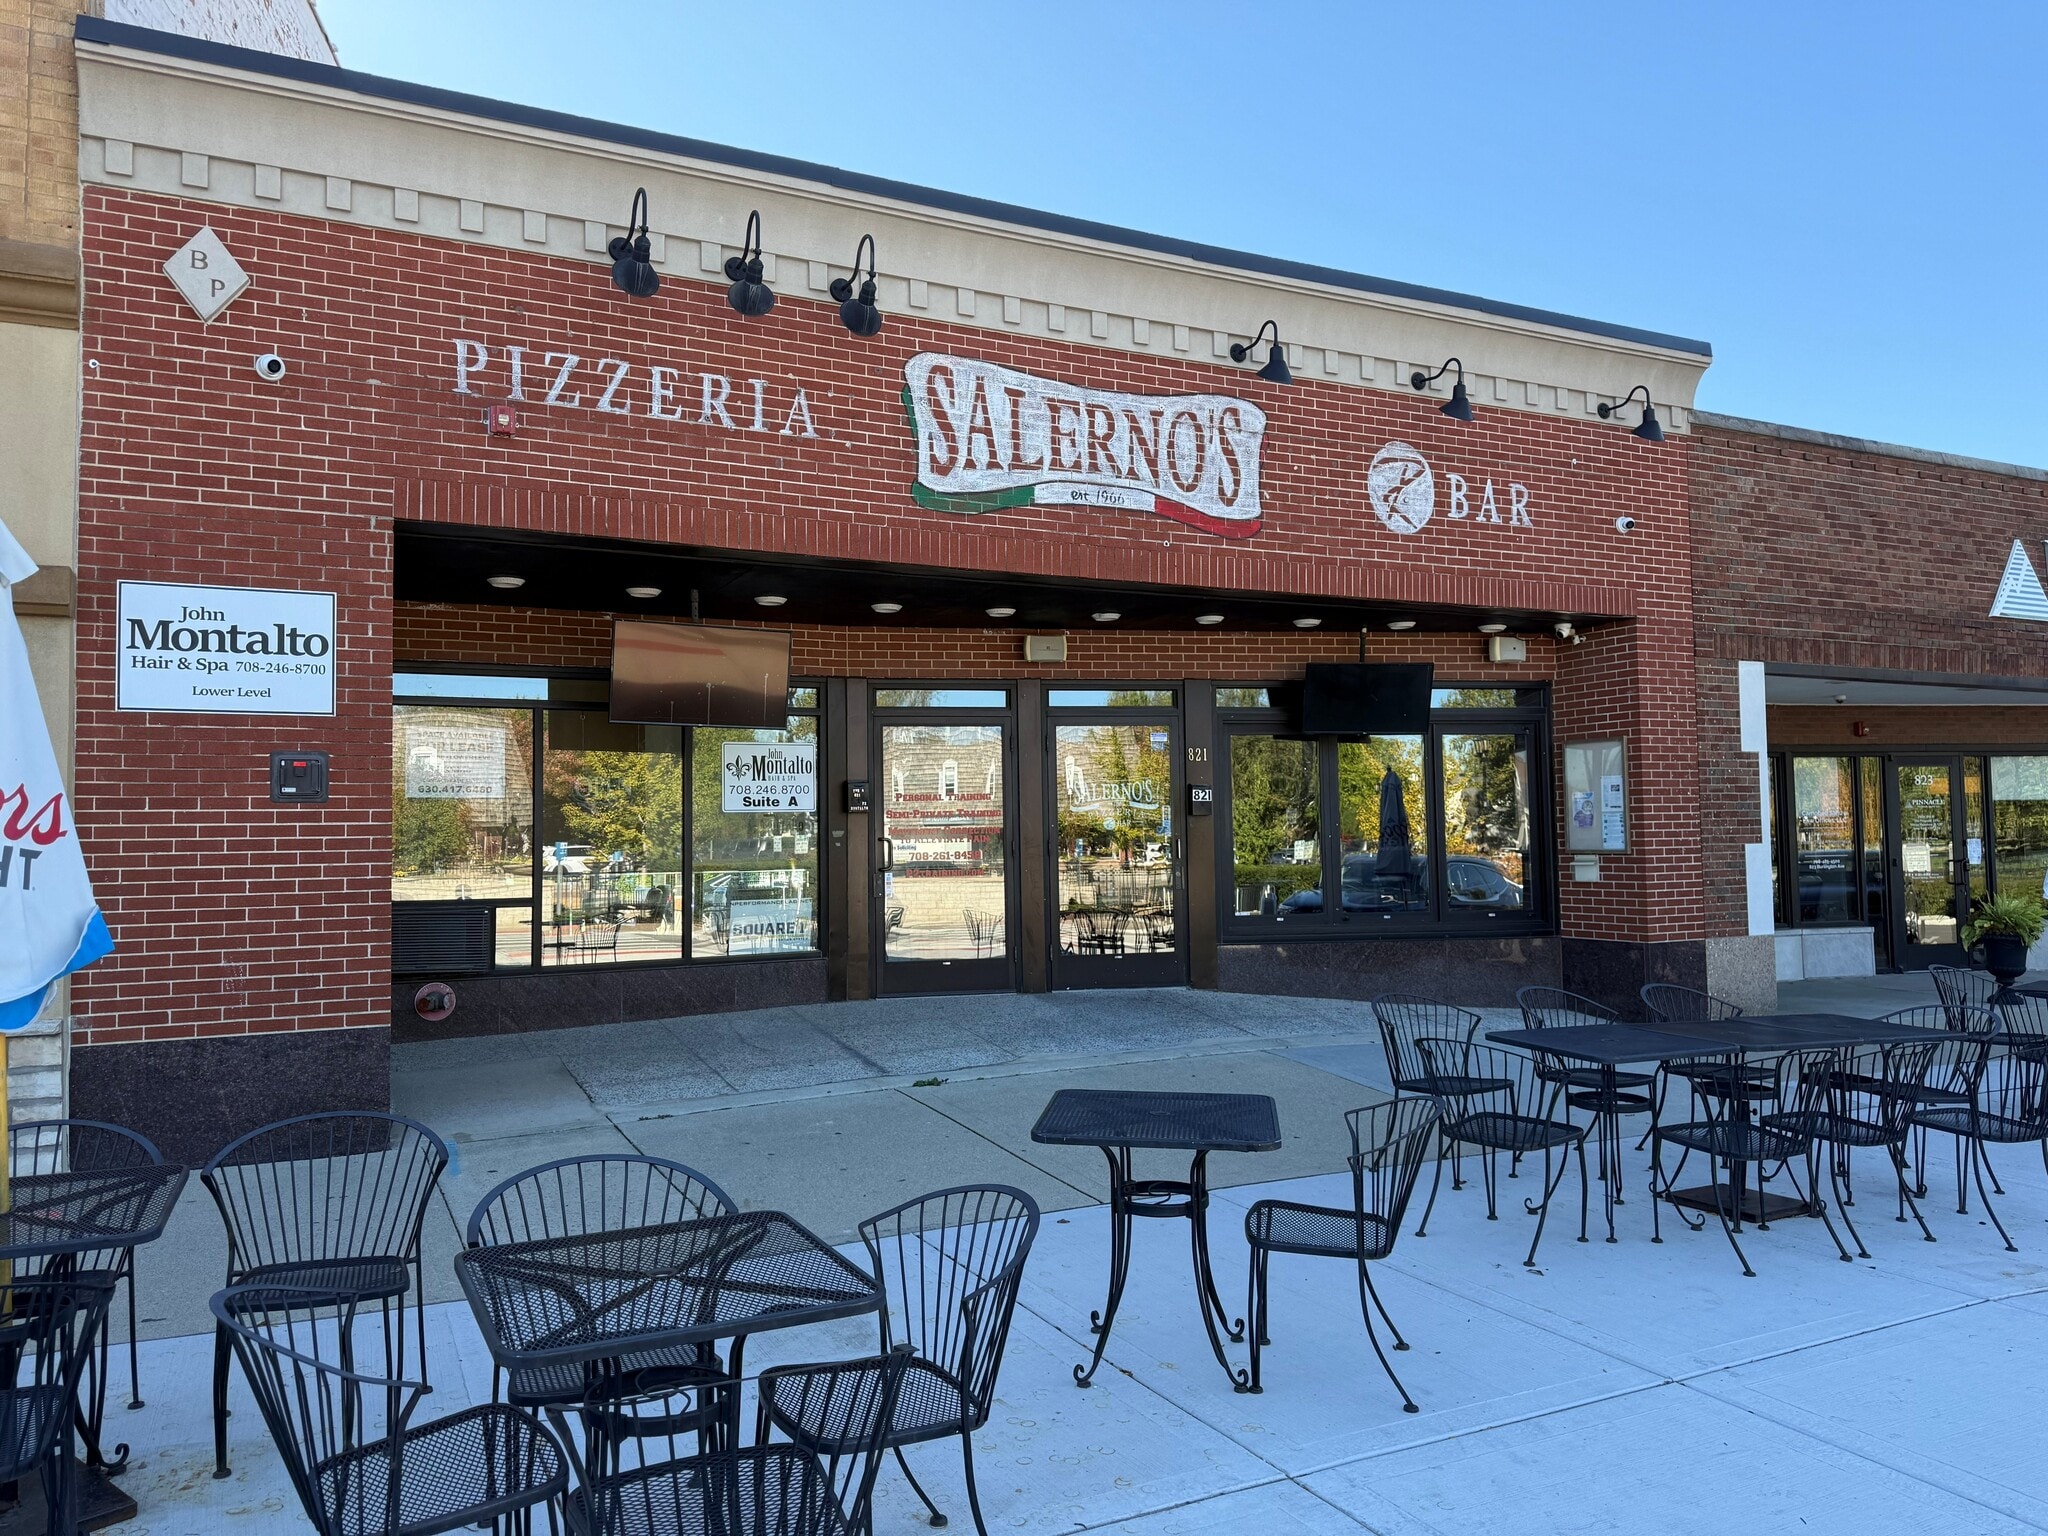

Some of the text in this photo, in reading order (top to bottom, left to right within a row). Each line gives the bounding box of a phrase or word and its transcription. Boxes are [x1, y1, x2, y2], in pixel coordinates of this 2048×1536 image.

[189, 249, 208, 270] B
[209, 278, 226, 298] P
[452, 338, 819, 438] PIZZERIA
[926, 364, 1243, 507] SALERNO'S
[1445, 473, 1534, 528] BAR
[178, 606, 225, 623] John
[126, 618, 329, 658] Montalto
[132, 655, 326, 676] Hair & Spa 708-246-8700
[192, 686, 271, 698] Lower Level
[767, 748, 783, 760] John
[1188, 747, 1207, 762] 821
[751, 755, 813, 782] Montalto
[1914, 775, 1934, 786] 823
[729, 785, 810, 795] 708.246.8700
[1073, 779, 1153, 805] SALERNO'S
[1193, 790, 1211, 801] 821
[742, 795, 798, 807] Suite A
[732, 922, 796, 936] SQUARE
